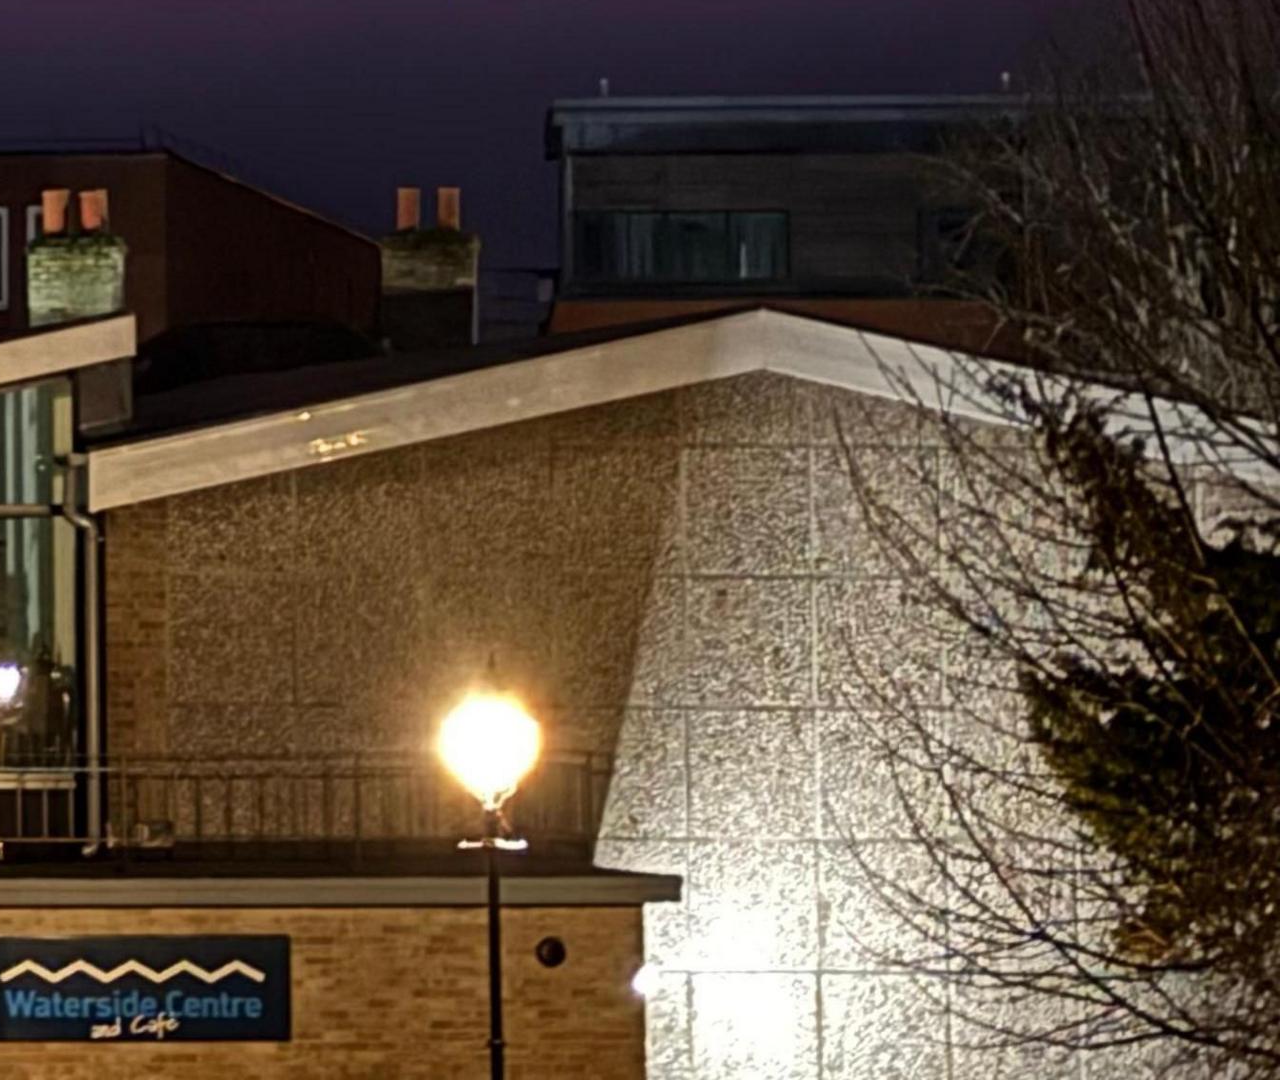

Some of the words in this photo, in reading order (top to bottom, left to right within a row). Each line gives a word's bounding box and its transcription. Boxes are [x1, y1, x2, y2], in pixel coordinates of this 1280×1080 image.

[4, 989, 157, 1019] Waterside
[165, 990, 263, 1018] Centre
[90, 1018, 122, 1039] and
